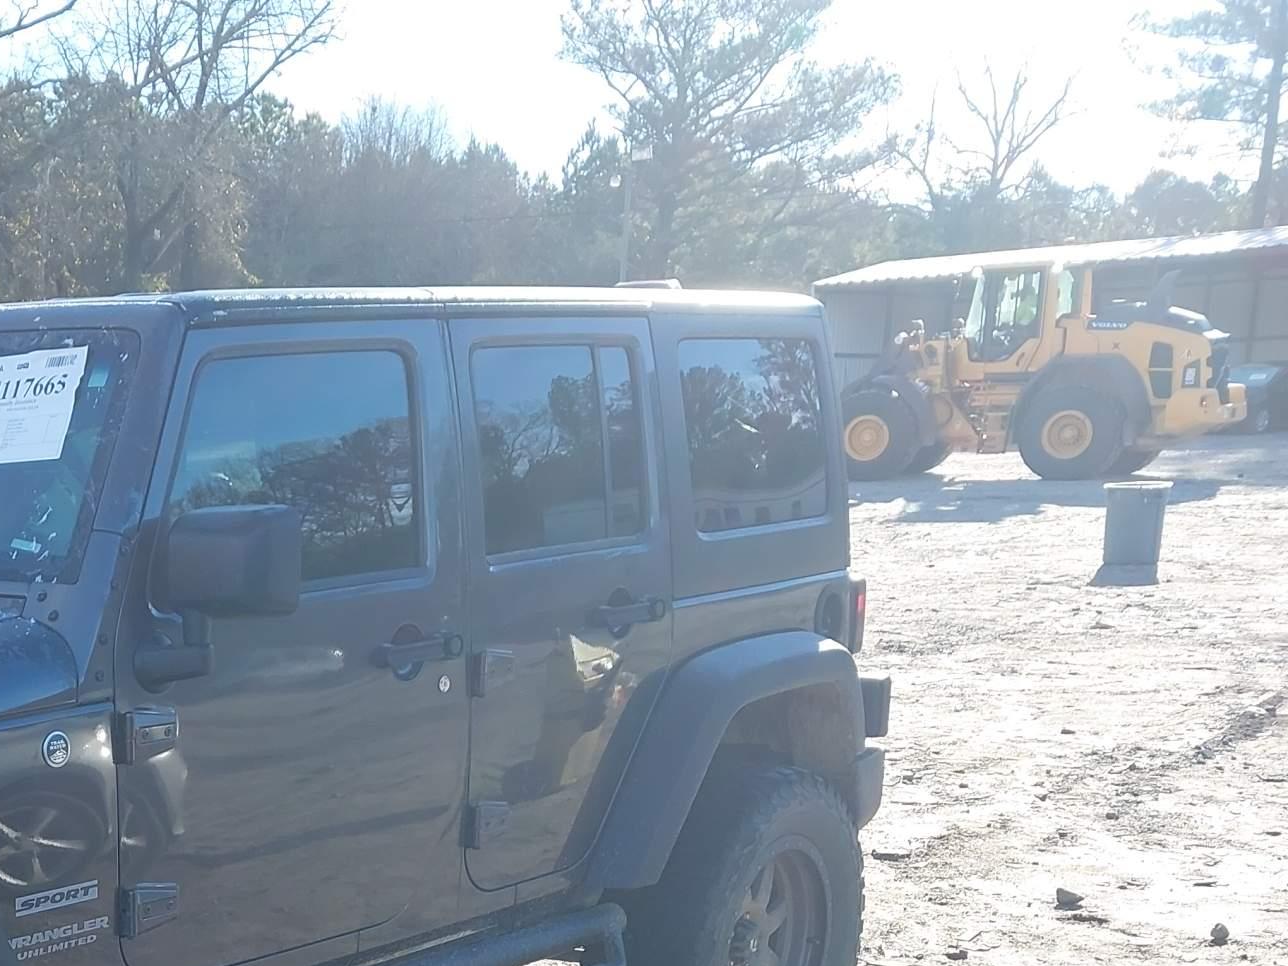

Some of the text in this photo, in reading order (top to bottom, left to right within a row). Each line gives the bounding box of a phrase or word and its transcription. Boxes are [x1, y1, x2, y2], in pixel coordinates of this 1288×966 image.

[1092, 321, 1128, 329] VOLVO
[20, 886, 91, 910] SPORT
[16, 934, 97, 961] UNLIMITED
